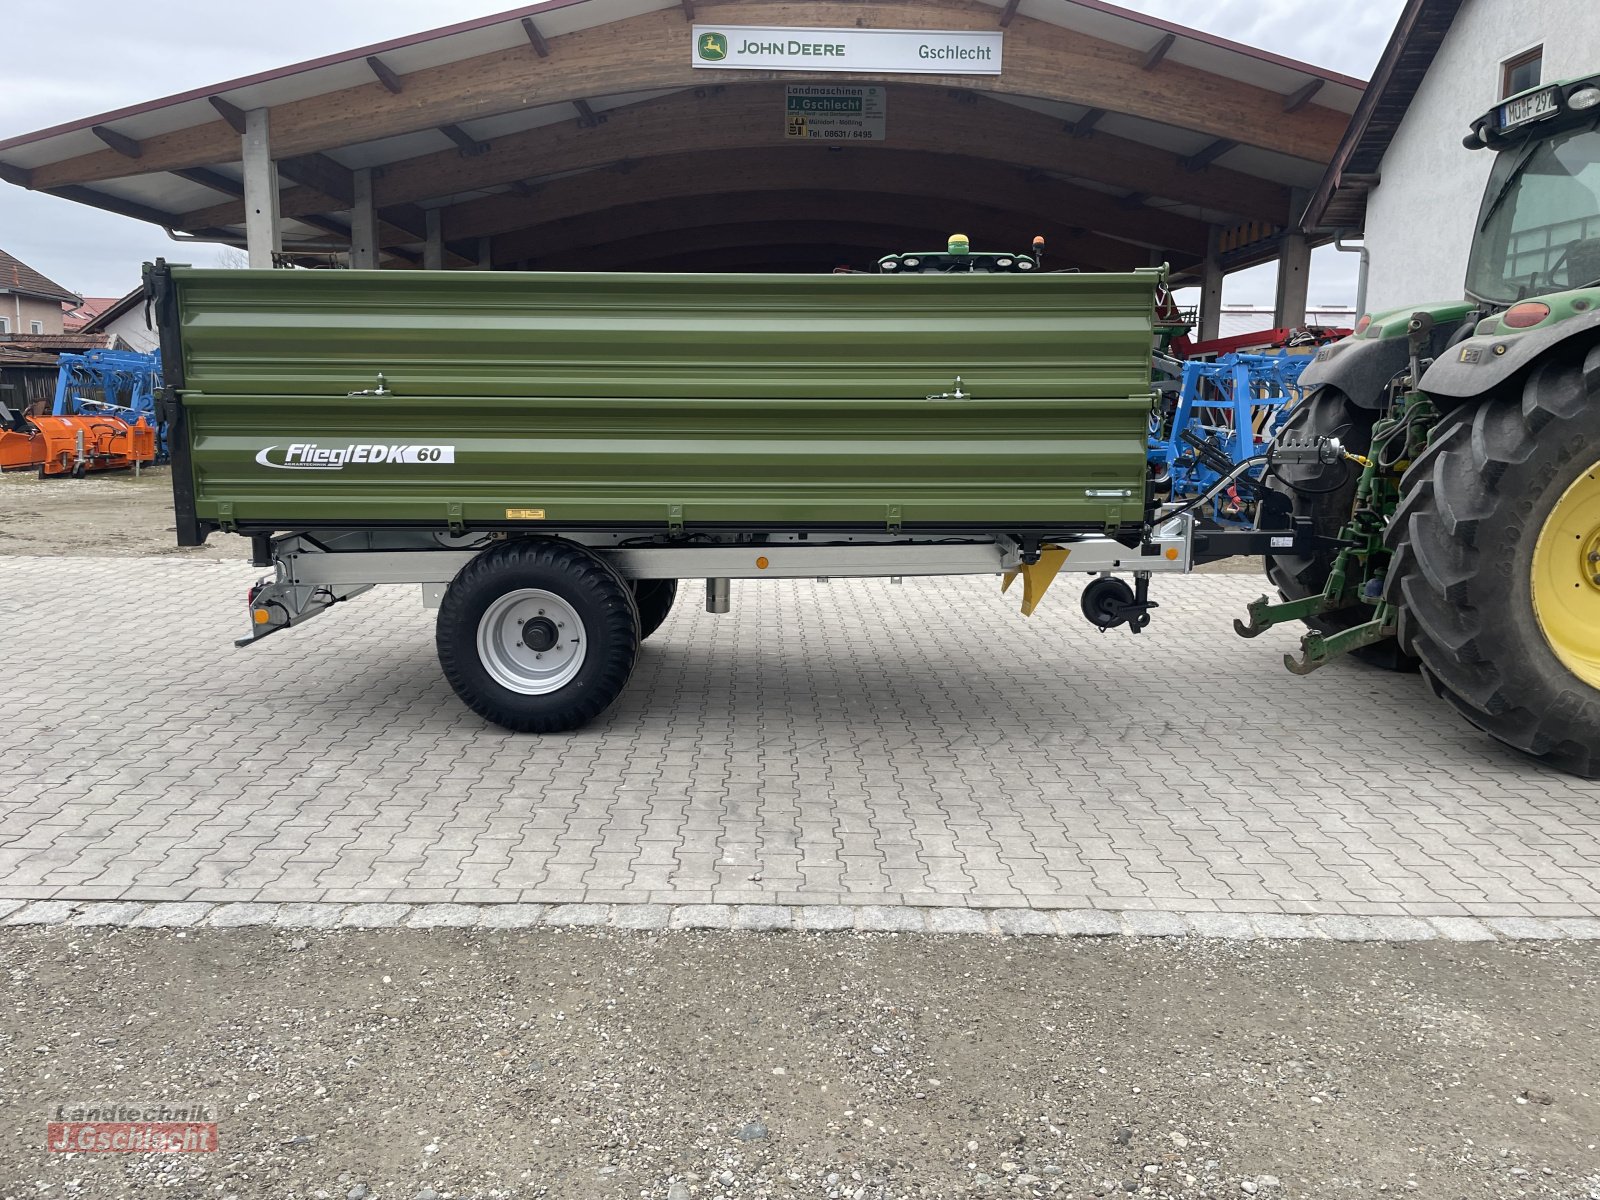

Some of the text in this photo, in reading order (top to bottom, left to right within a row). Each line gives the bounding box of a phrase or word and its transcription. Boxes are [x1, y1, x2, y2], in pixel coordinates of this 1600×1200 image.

[737, 39, 845, 57] JOHN DEERE
[918, 44, 991, 60] Gschlecht
[787, 86, 863, 96] Landmaschinen
[790, 99, 861, 110] J. Gschlecht
[808, 129, 821, 138] Tel.
[416, 447, 442, 462] 60
